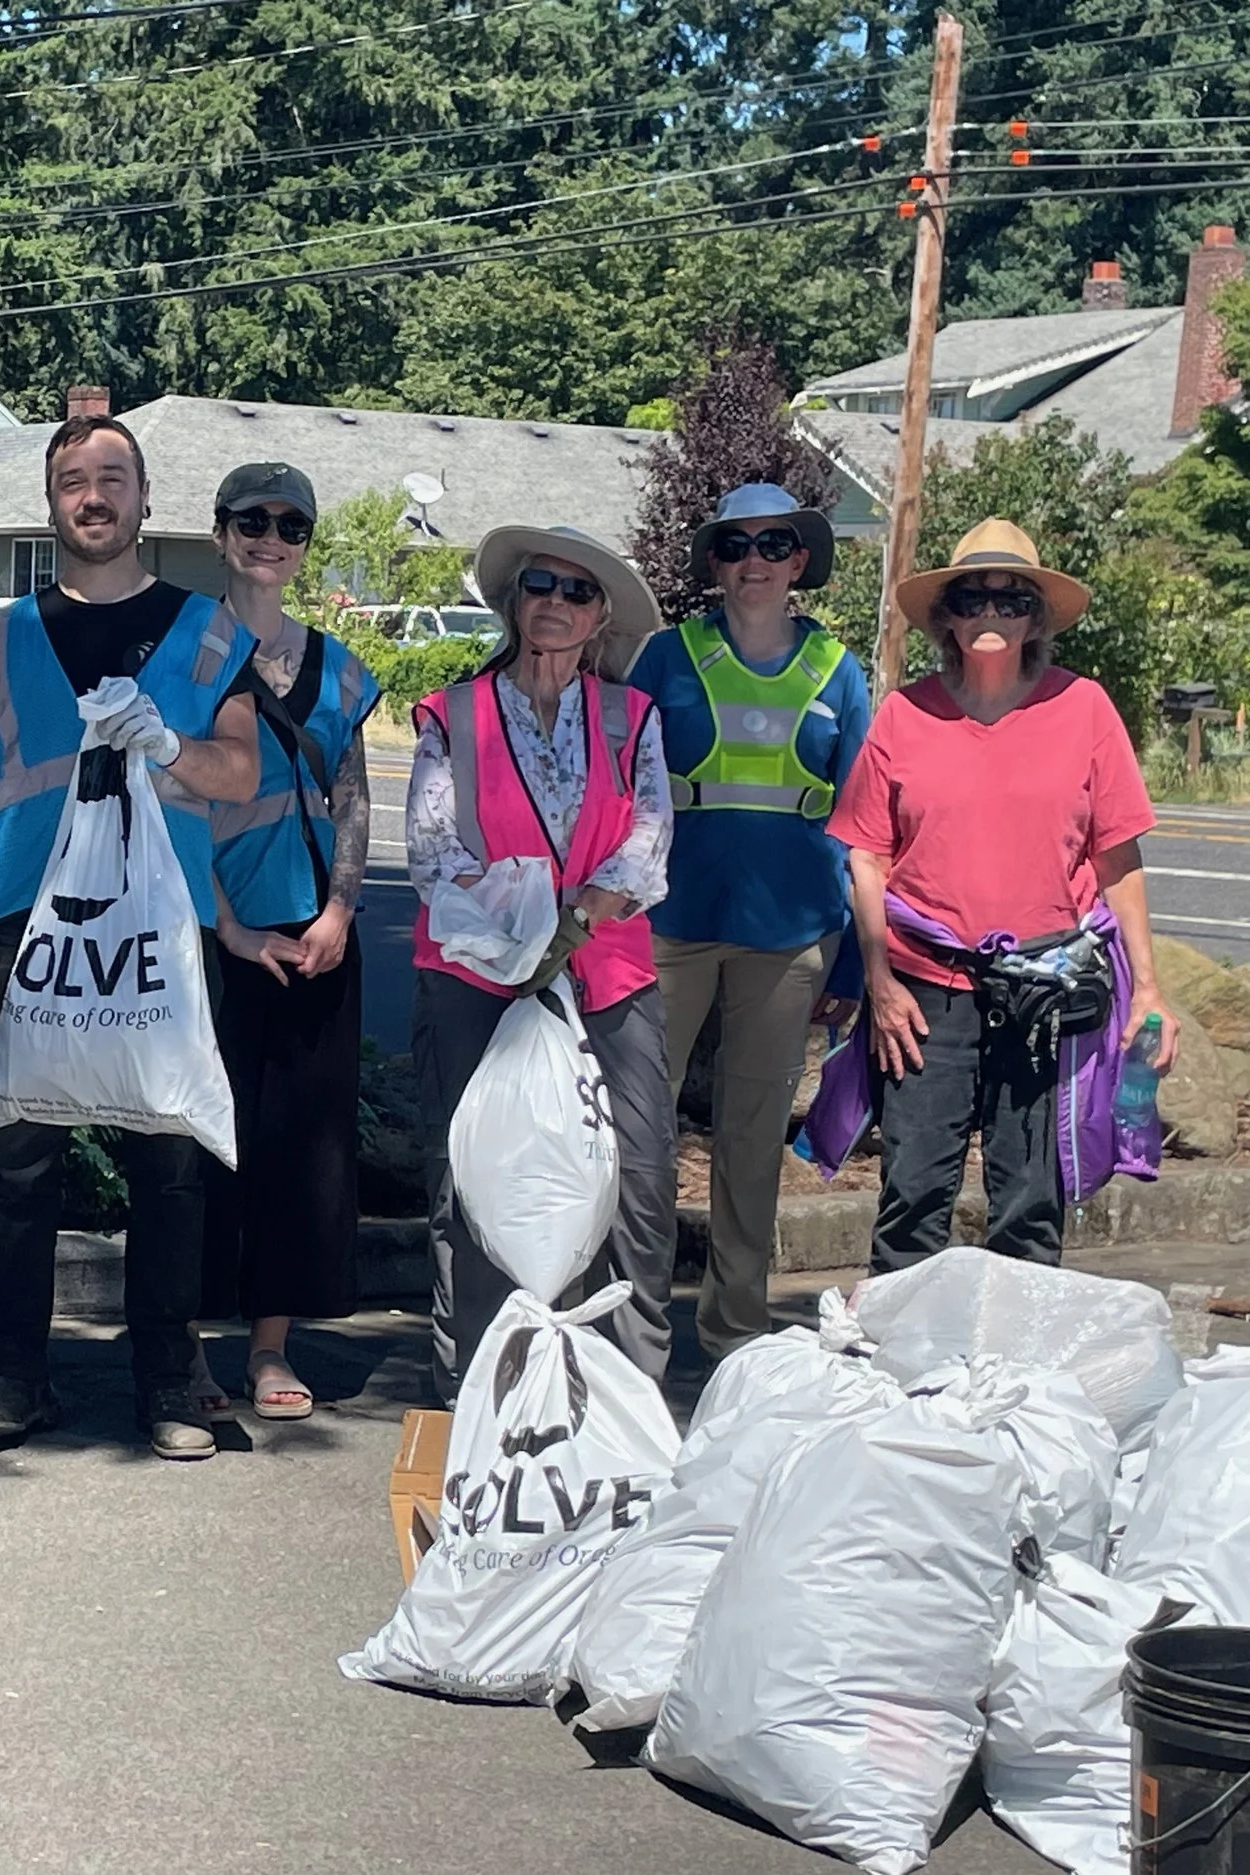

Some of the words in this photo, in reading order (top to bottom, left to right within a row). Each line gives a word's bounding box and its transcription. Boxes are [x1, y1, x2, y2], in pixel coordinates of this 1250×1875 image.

[14, 930, 166, 997] OLVE
[29, 1006, 66, 1028] Care
[72, 1007, 97, 1032] of
[98, 1005, 174, 1031] Oregon
[473, 1548, 523, 1570] Care
[529, 1545, 556, 1572] of
[486, 1673, 518, 1685] your
